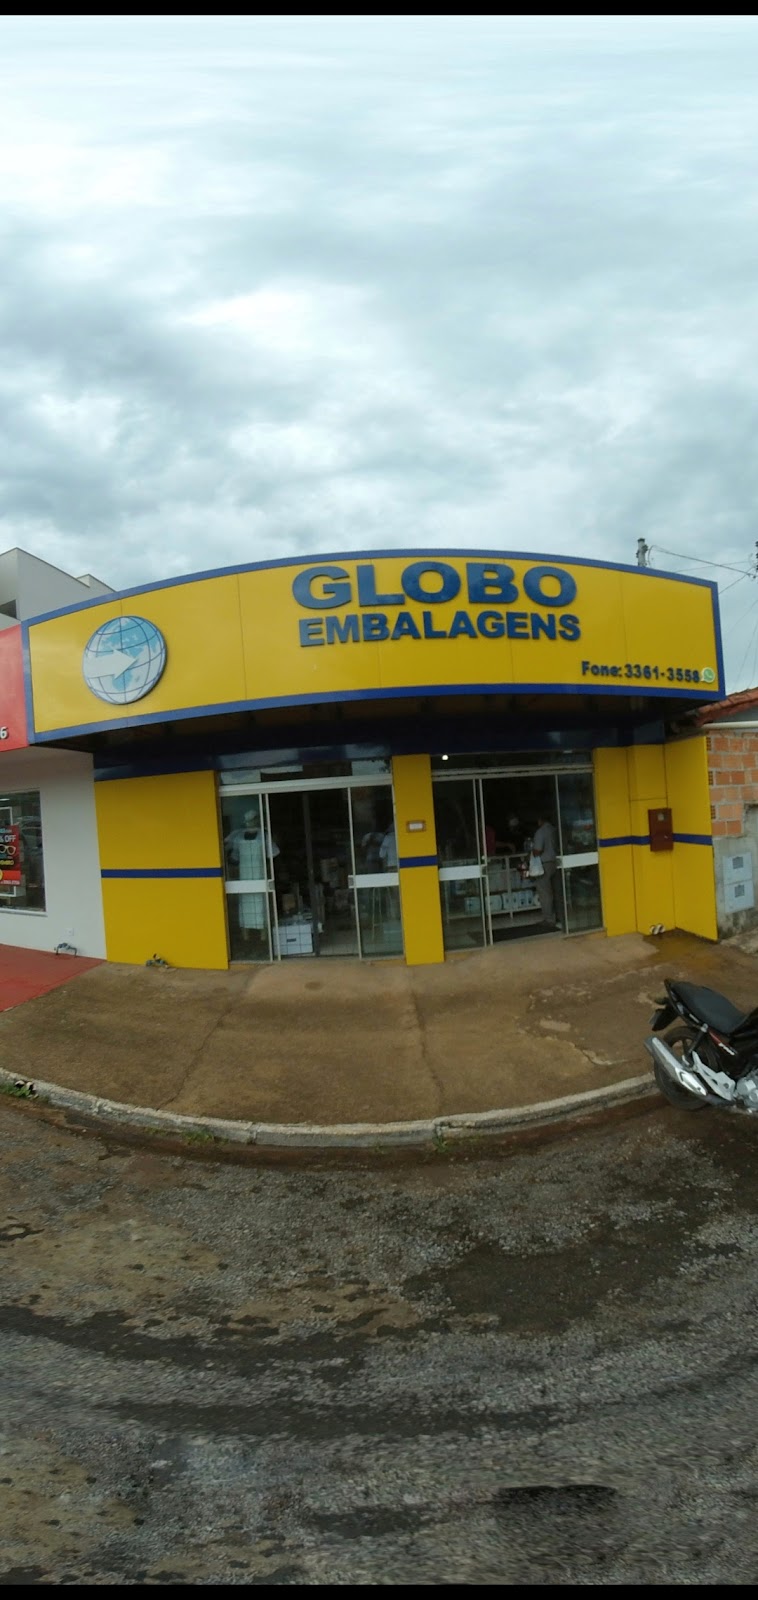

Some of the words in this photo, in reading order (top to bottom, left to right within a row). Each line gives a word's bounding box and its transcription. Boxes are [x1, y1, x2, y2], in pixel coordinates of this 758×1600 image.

[292, 561, 578, 610] GLOBO
[298, 610, 582, 647] EMBALAGENS
[581, 660, 622, 677] Fone:
[624, 663, 700, 683] 3361-3558
